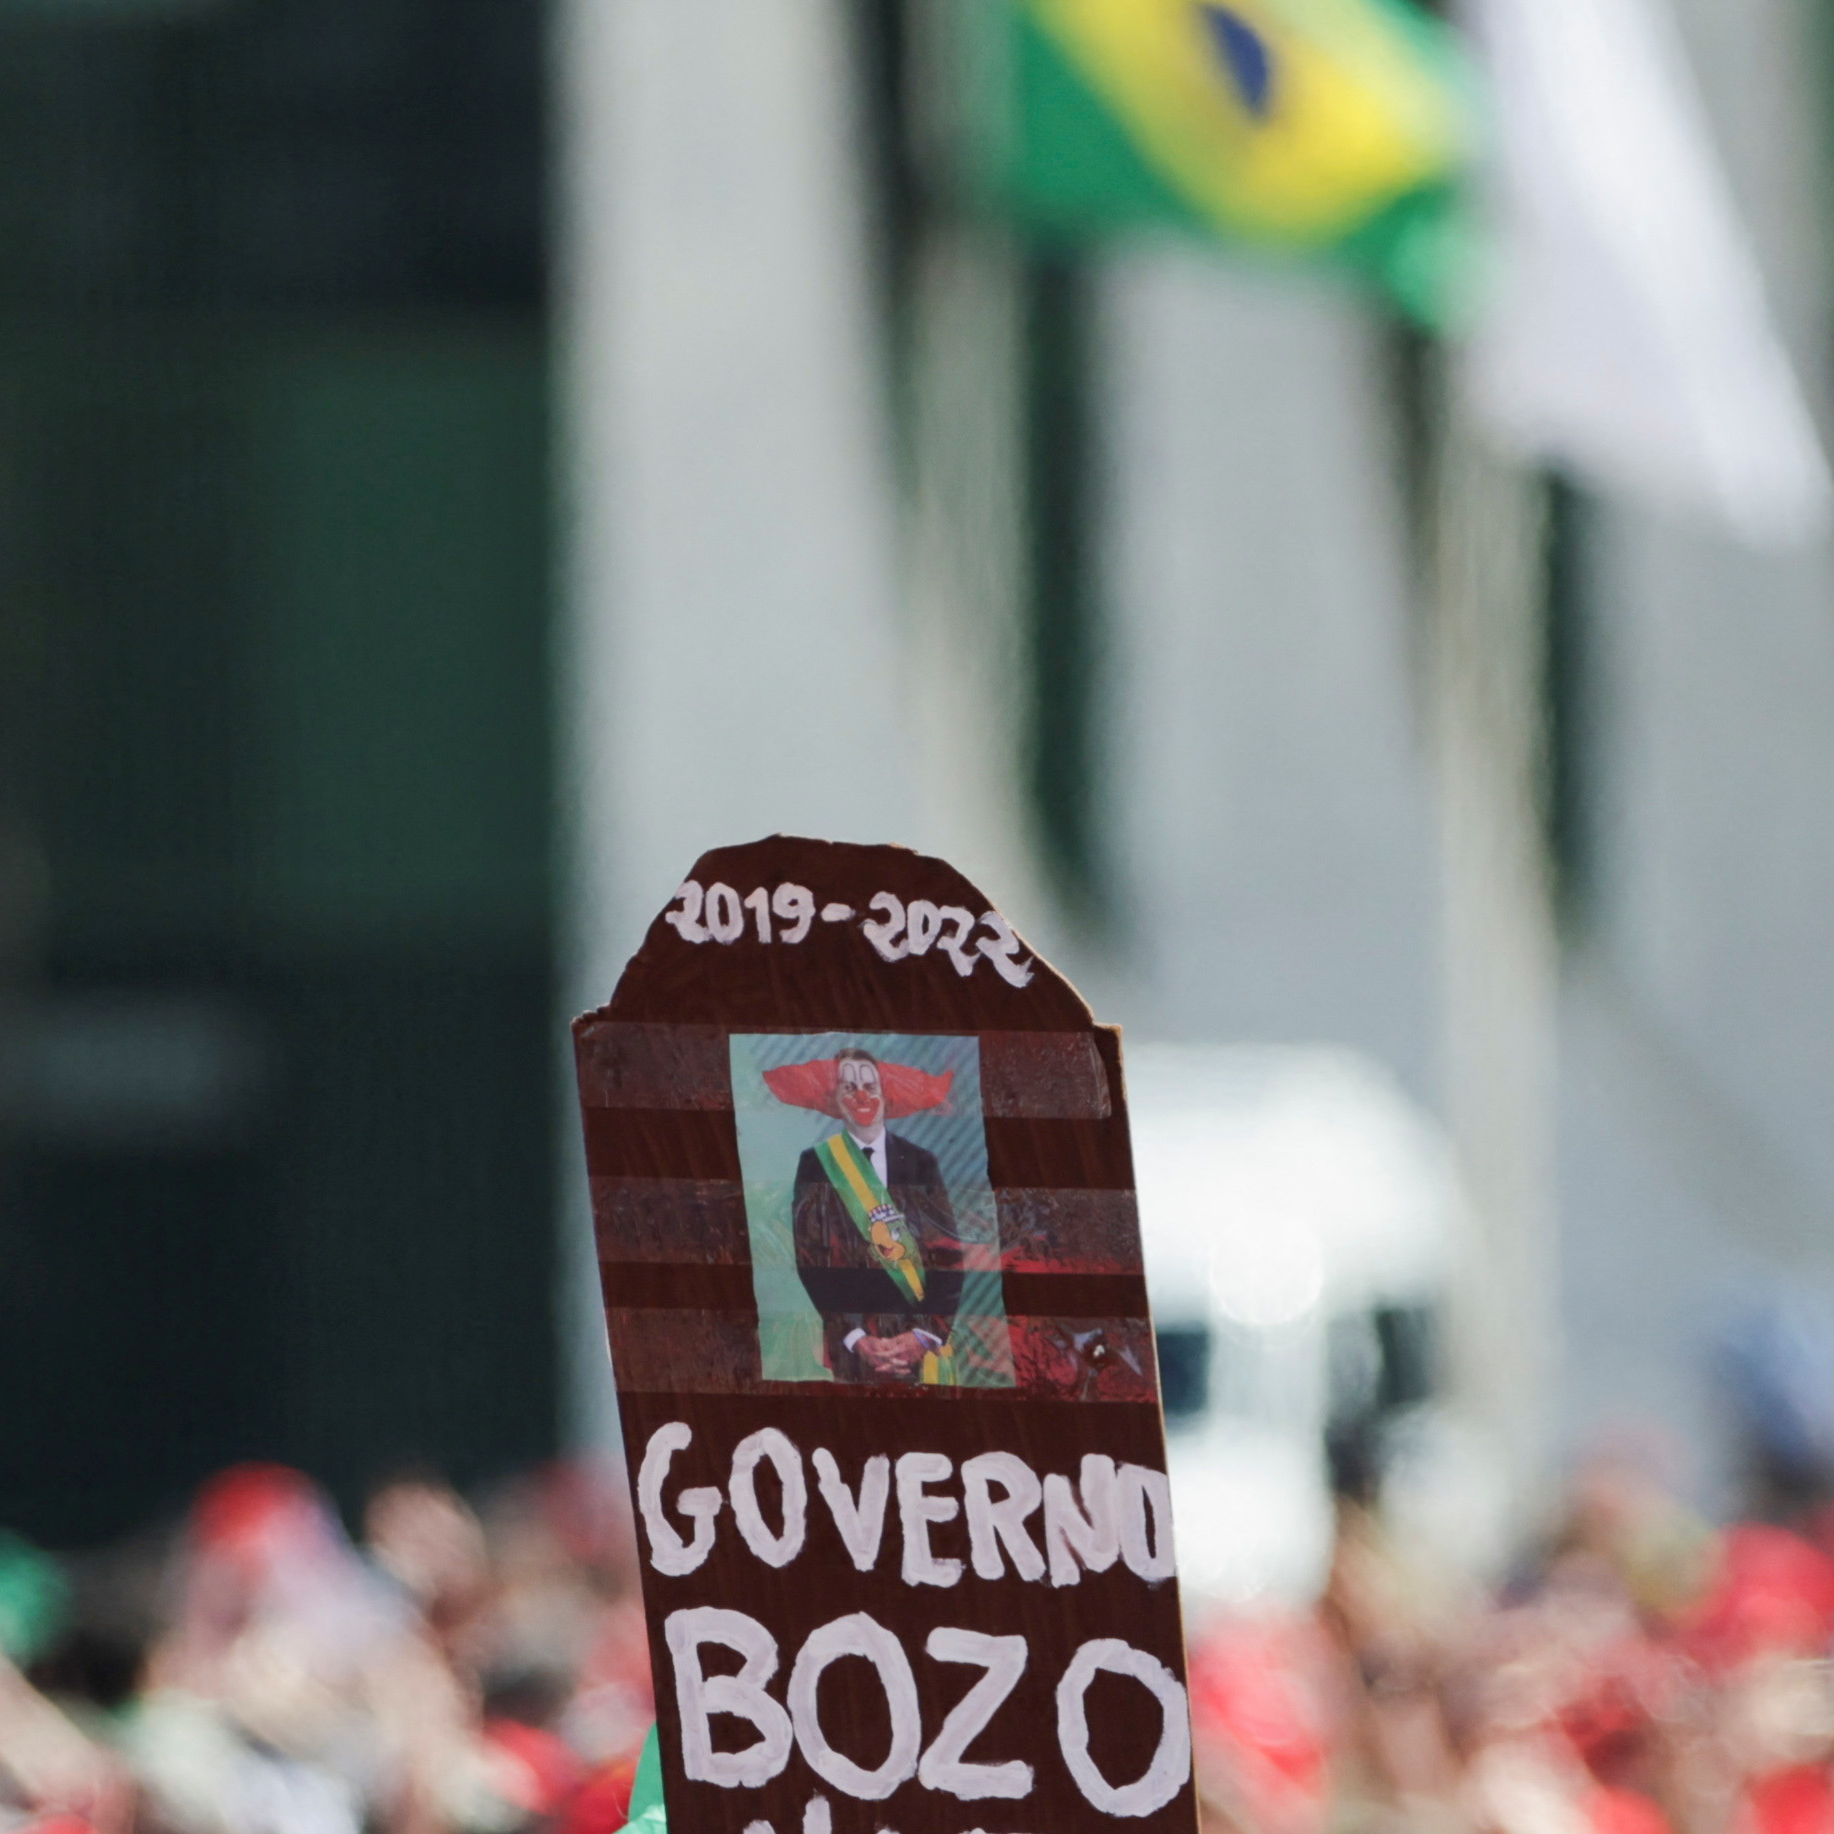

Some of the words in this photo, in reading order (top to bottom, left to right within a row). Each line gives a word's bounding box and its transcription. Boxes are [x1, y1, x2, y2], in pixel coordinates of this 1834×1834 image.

[665, 880, 1034, 989] 2019-2022
[639, 1421, 1176, 1588] GOVERNO
[665, 1607, 1190, 1817] BOZO
